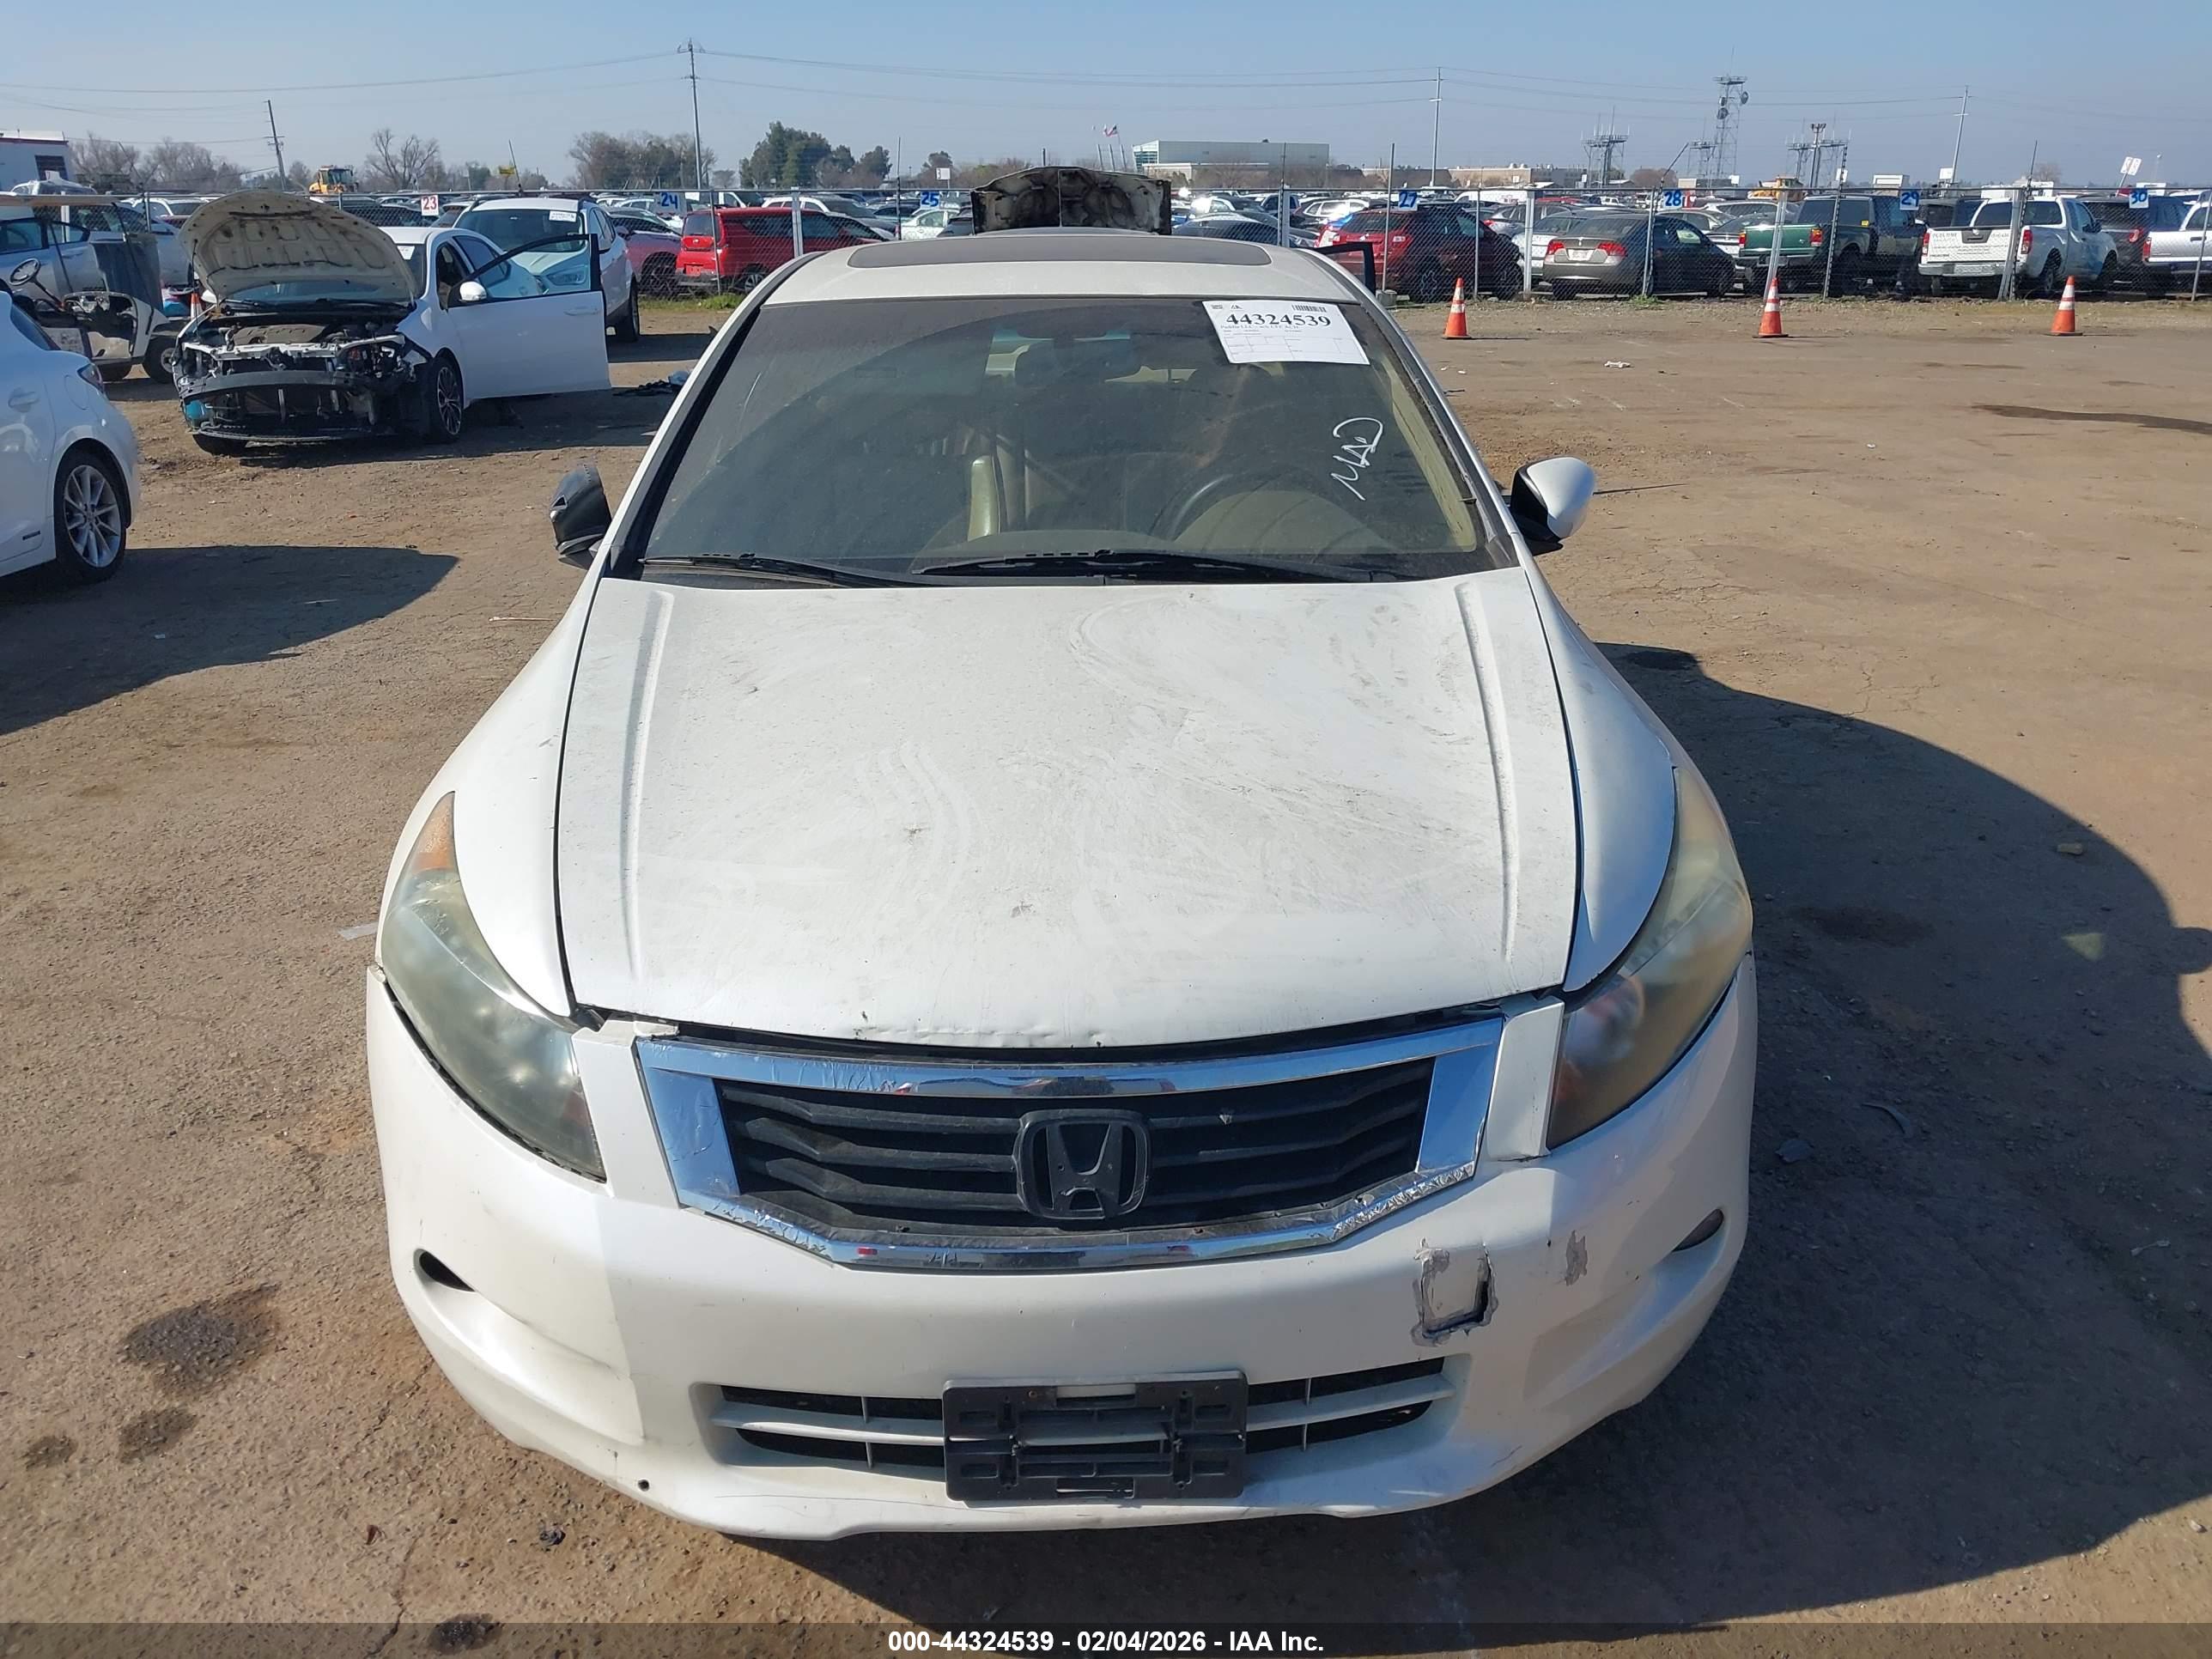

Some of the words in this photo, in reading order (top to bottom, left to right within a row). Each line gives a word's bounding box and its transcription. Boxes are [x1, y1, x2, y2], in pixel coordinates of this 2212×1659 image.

[422, 196, 437, 210] 23
[661, 191, 678, 209] 24
[921, 191, 939, 207] 25
[1399, 191, 1418, 208] 27
[1664, 190, 1682, 207] 28
[1901, 191, 1920, 208] 29
[2130, 191, 2148, 204] 30
[1226, 313, 1332, 327] 44324539
